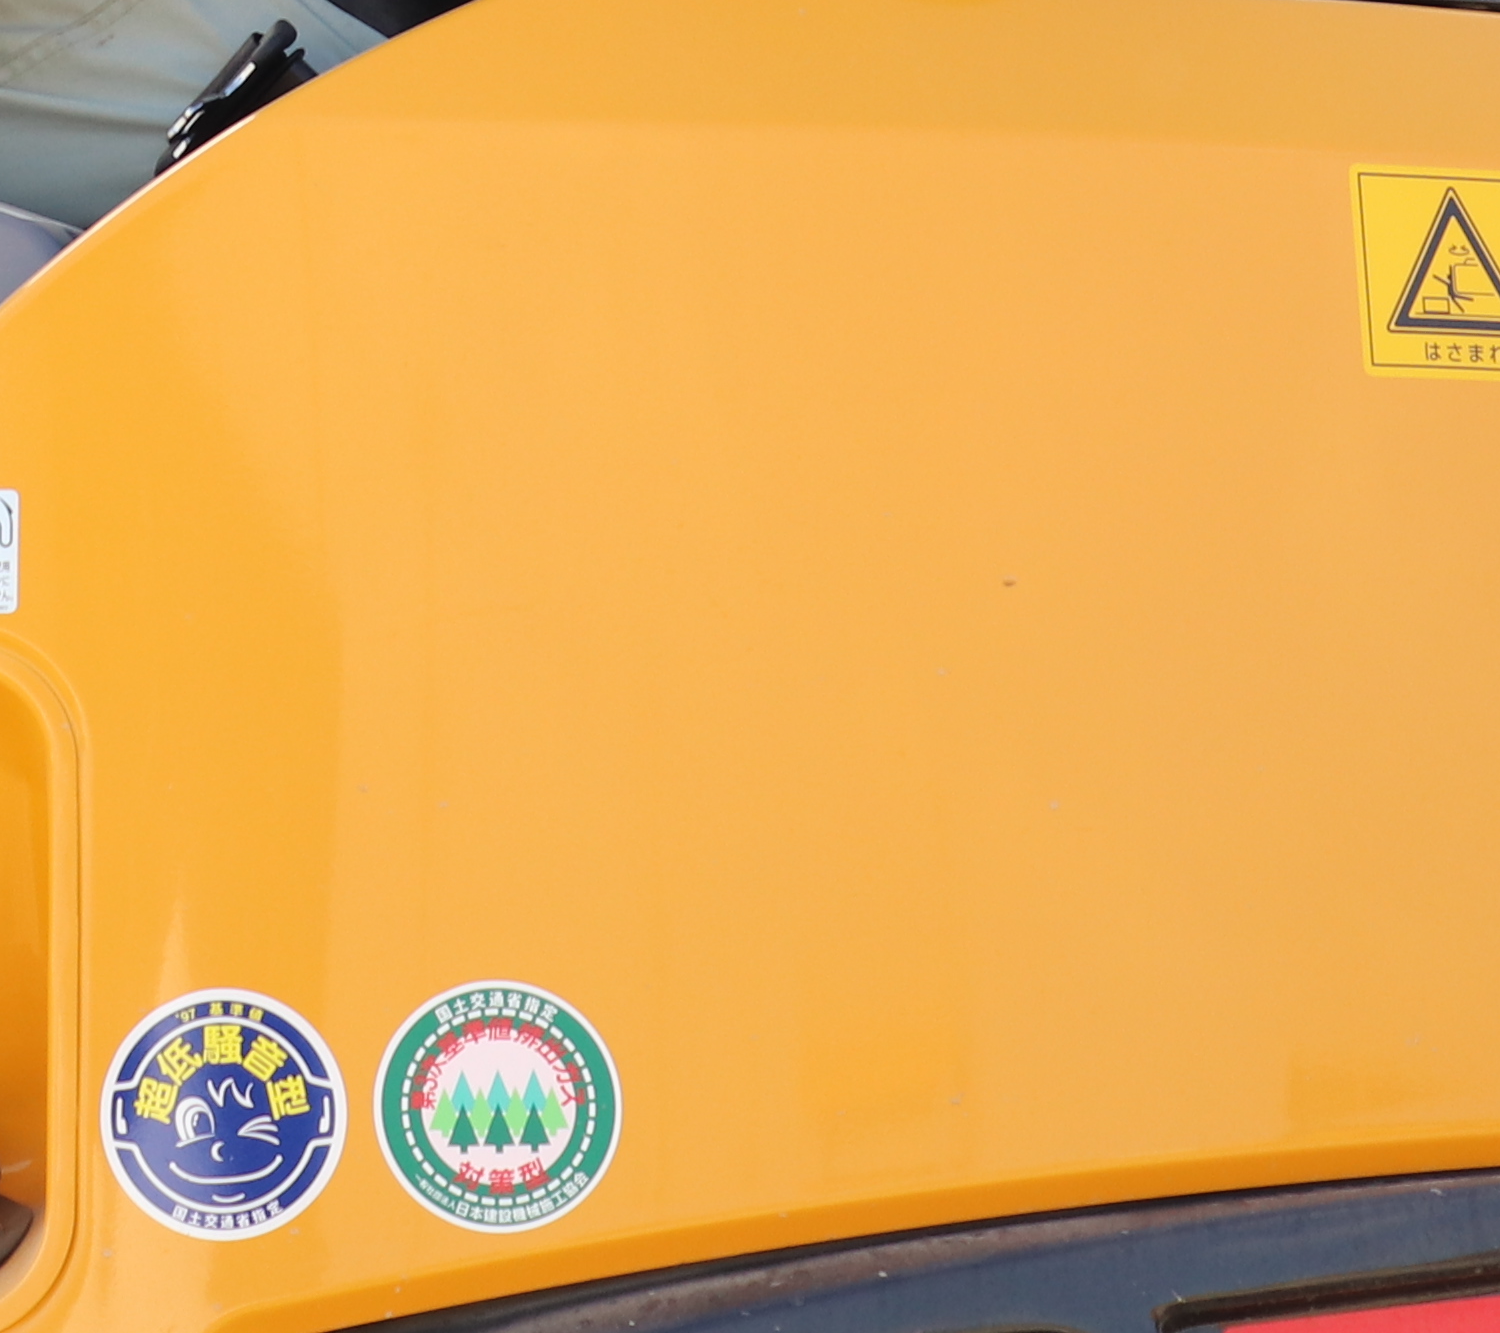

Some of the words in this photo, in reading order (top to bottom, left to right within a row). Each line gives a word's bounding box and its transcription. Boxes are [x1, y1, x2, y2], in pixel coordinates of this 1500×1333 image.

[210, 1002, 264, 1024] 基準値
[435, 990, 559, 1024] 国土交通省指定
[133, 1024, 311, 1125] 超低騒音型
[454, 1157, 550, 1194] 対策型
[172, 1200, 283, 1229] 国土交通省指定
